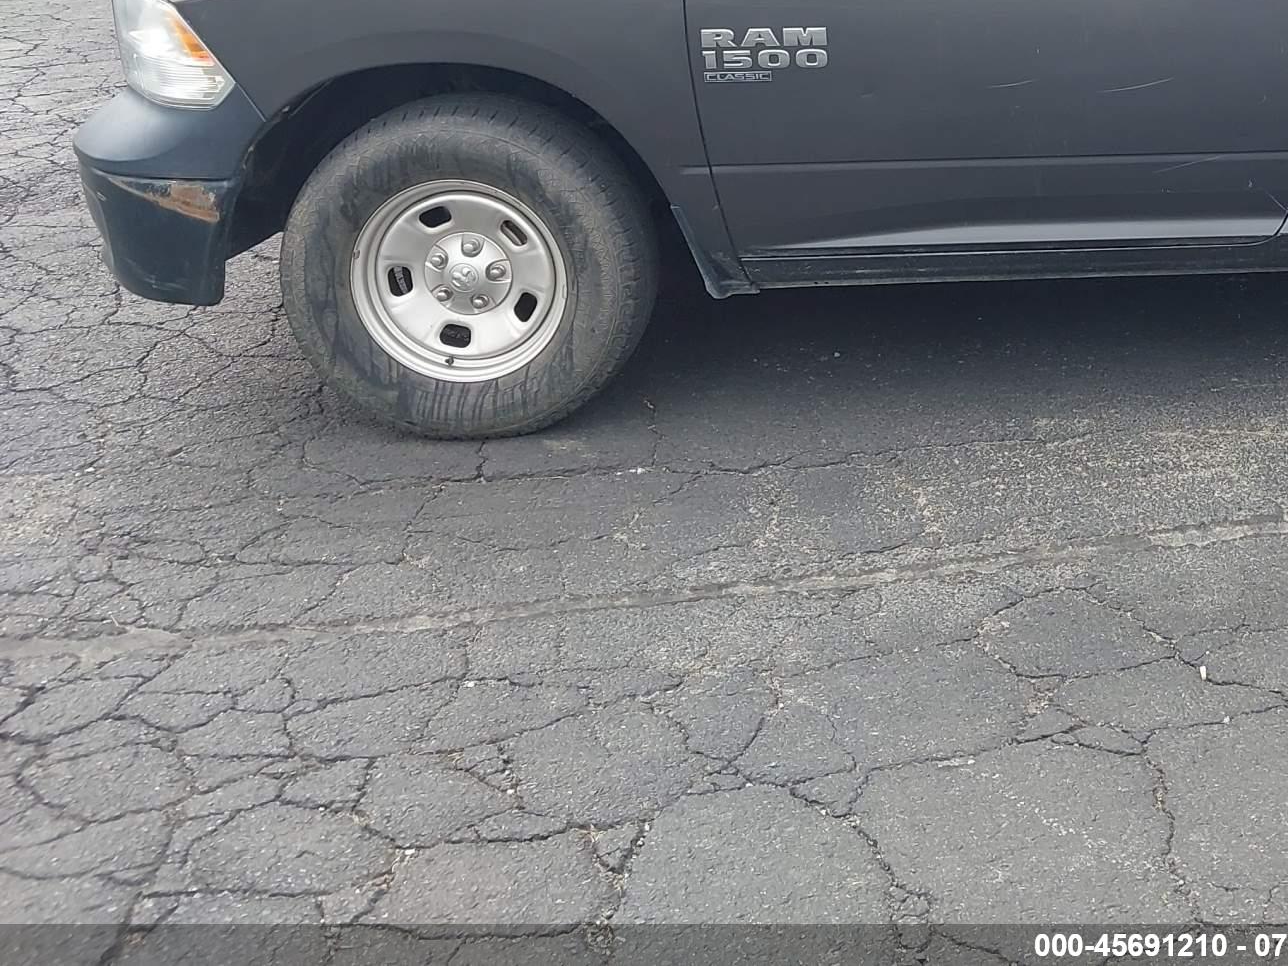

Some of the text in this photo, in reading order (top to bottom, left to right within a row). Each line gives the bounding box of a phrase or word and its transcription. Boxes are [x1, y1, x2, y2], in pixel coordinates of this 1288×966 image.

[700, 27, 828, 48] RAM
[702, 48, 828, 69] 1500
[705, 72, 770, 81] CLASSIC
